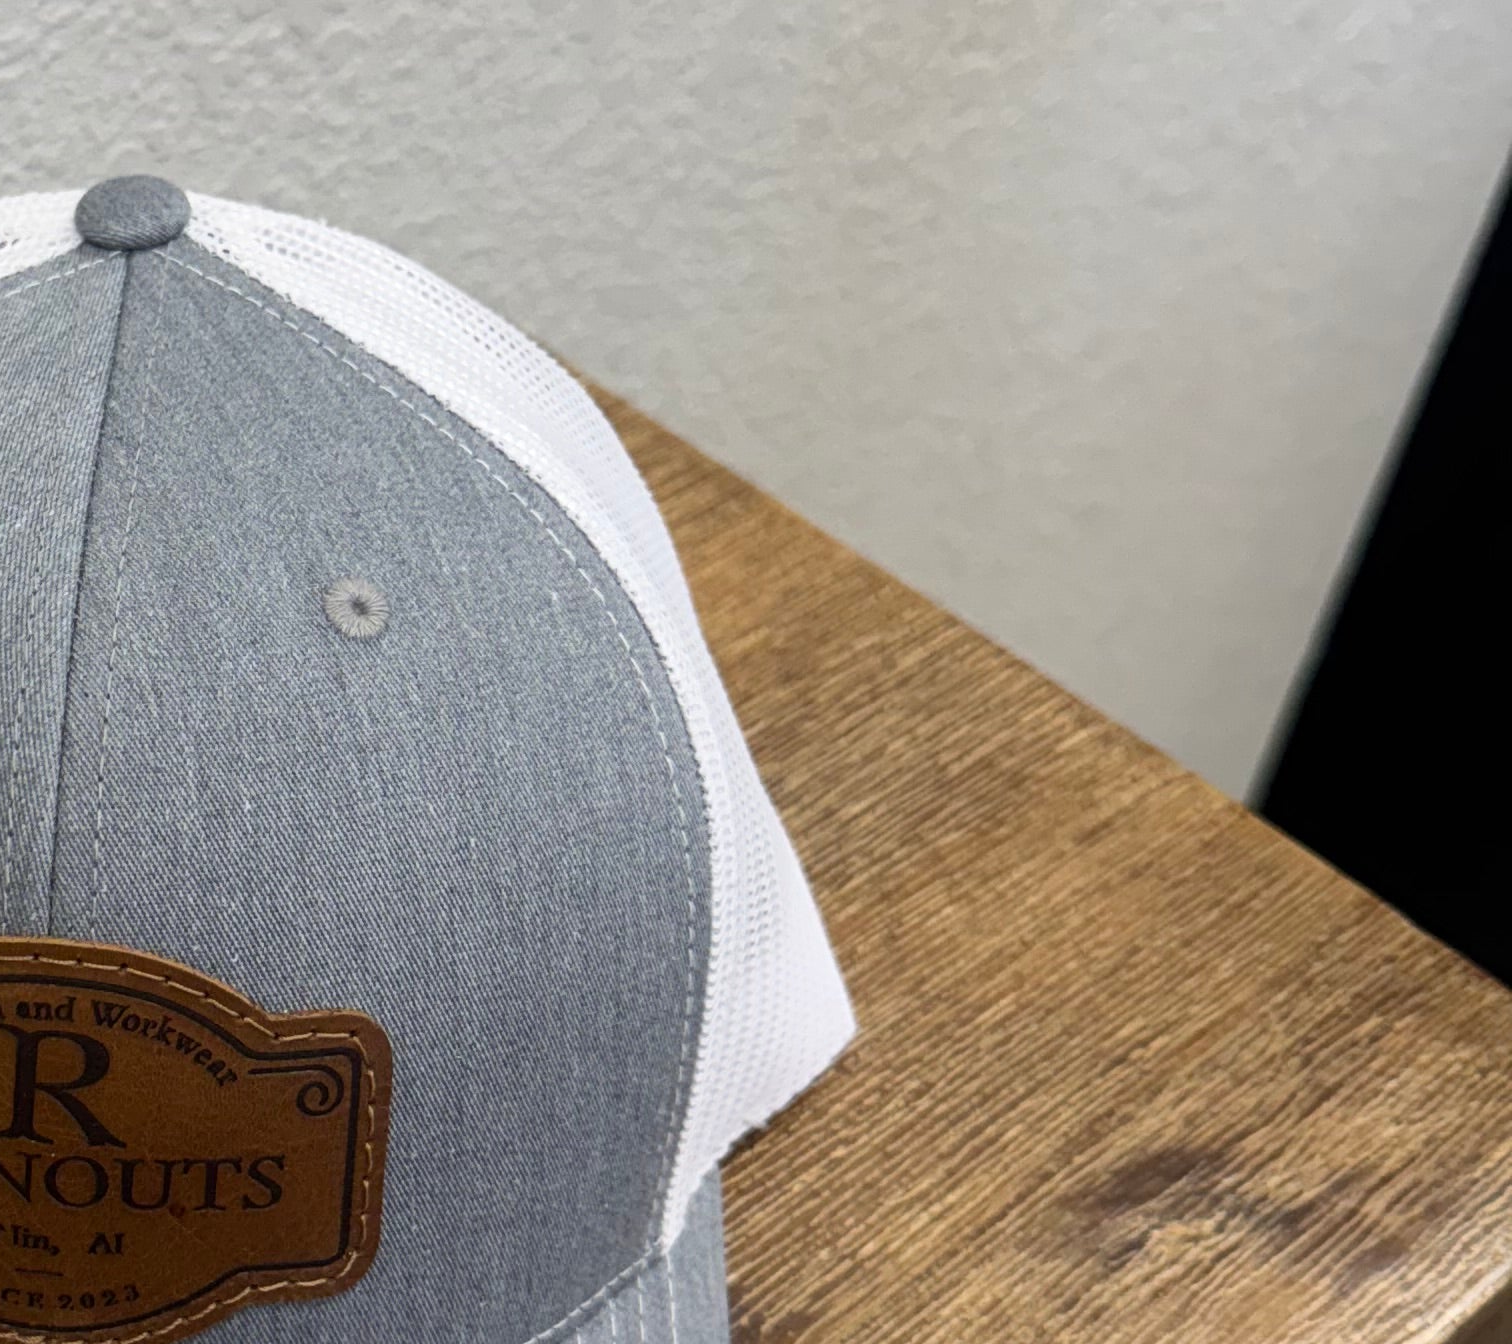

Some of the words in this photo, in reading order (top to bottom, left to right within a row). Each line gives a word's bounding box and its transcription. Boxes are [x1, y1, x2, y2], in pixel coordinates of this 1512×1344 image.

[16, 997, 75, 1024] and
[90, 999, 239, 1088] Workwear
[57, 1283, 141, 1312] 2023
